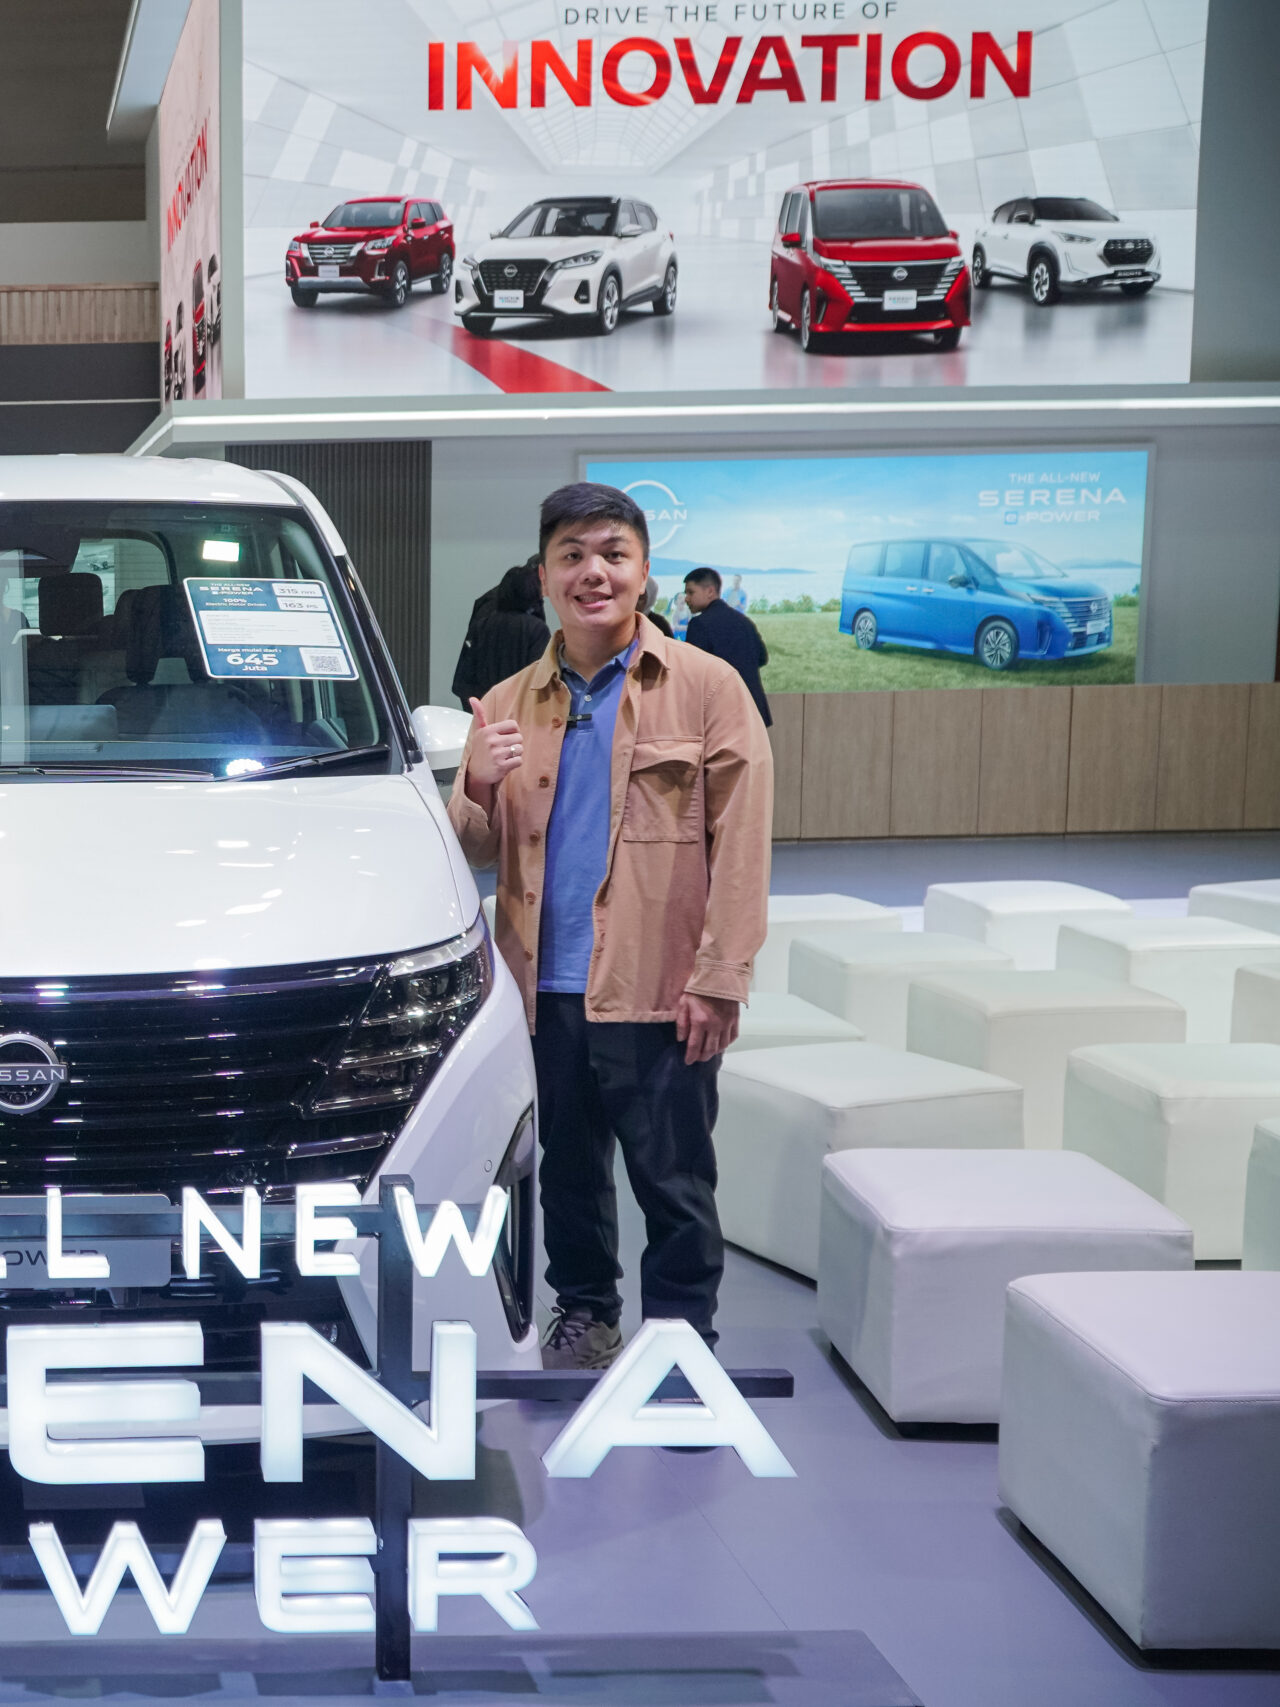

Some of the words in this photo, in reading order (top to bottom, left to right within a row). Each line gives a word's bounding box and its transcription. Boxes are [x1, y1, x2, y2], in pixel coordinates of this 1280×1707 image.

[563, 6, 650, 26] DRIVE
[665, 4, 719, 23] THE
[732, 2, 847, 22] FUTURE
[860, 1, 899, 20] OF
[428, 31, 1034, 111] INNOVATION
[1009, 472, 1035, 484] THE
[1039, 471, 1102, 484] ALL-NEW
[978, 487, 1128, 507] SERENA
[643, 508, 688, 521] SAN
[226, 652, 279, 666] 645
[181, 1182, 510, 1280] NEW
